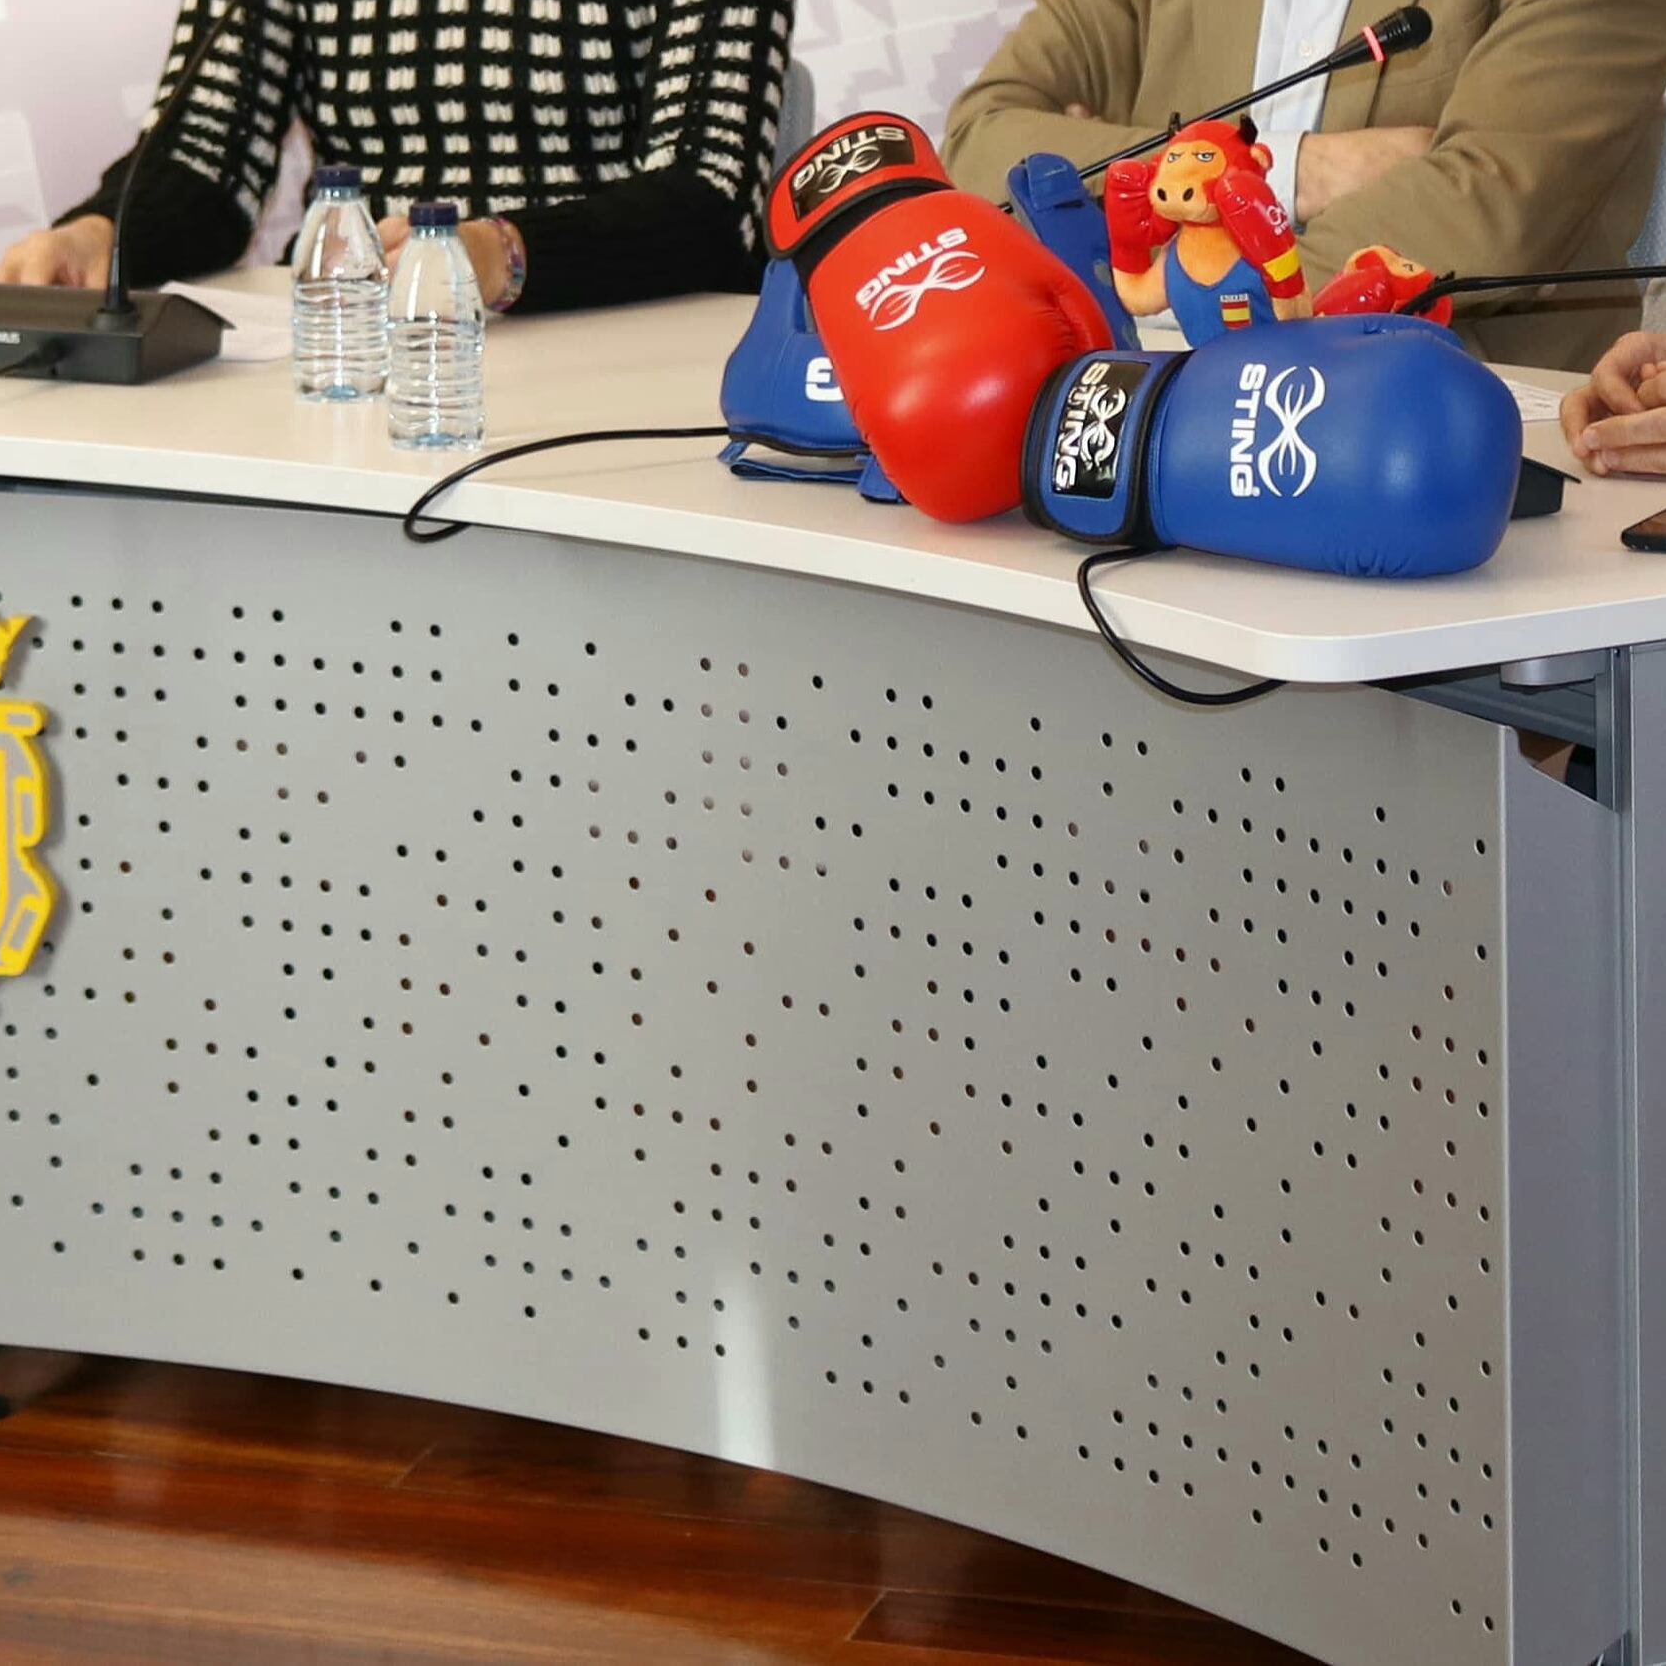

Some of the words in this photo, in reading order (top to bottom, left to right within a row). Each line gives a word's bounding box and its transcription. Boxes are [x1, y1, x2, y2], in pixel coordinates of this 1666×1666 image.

[793, 126, 907, 191] STING
[855, 227, 968, 310] STING
[1054, 362, 1111, 492] STING
[1230, 362, 1268, 498] STING
